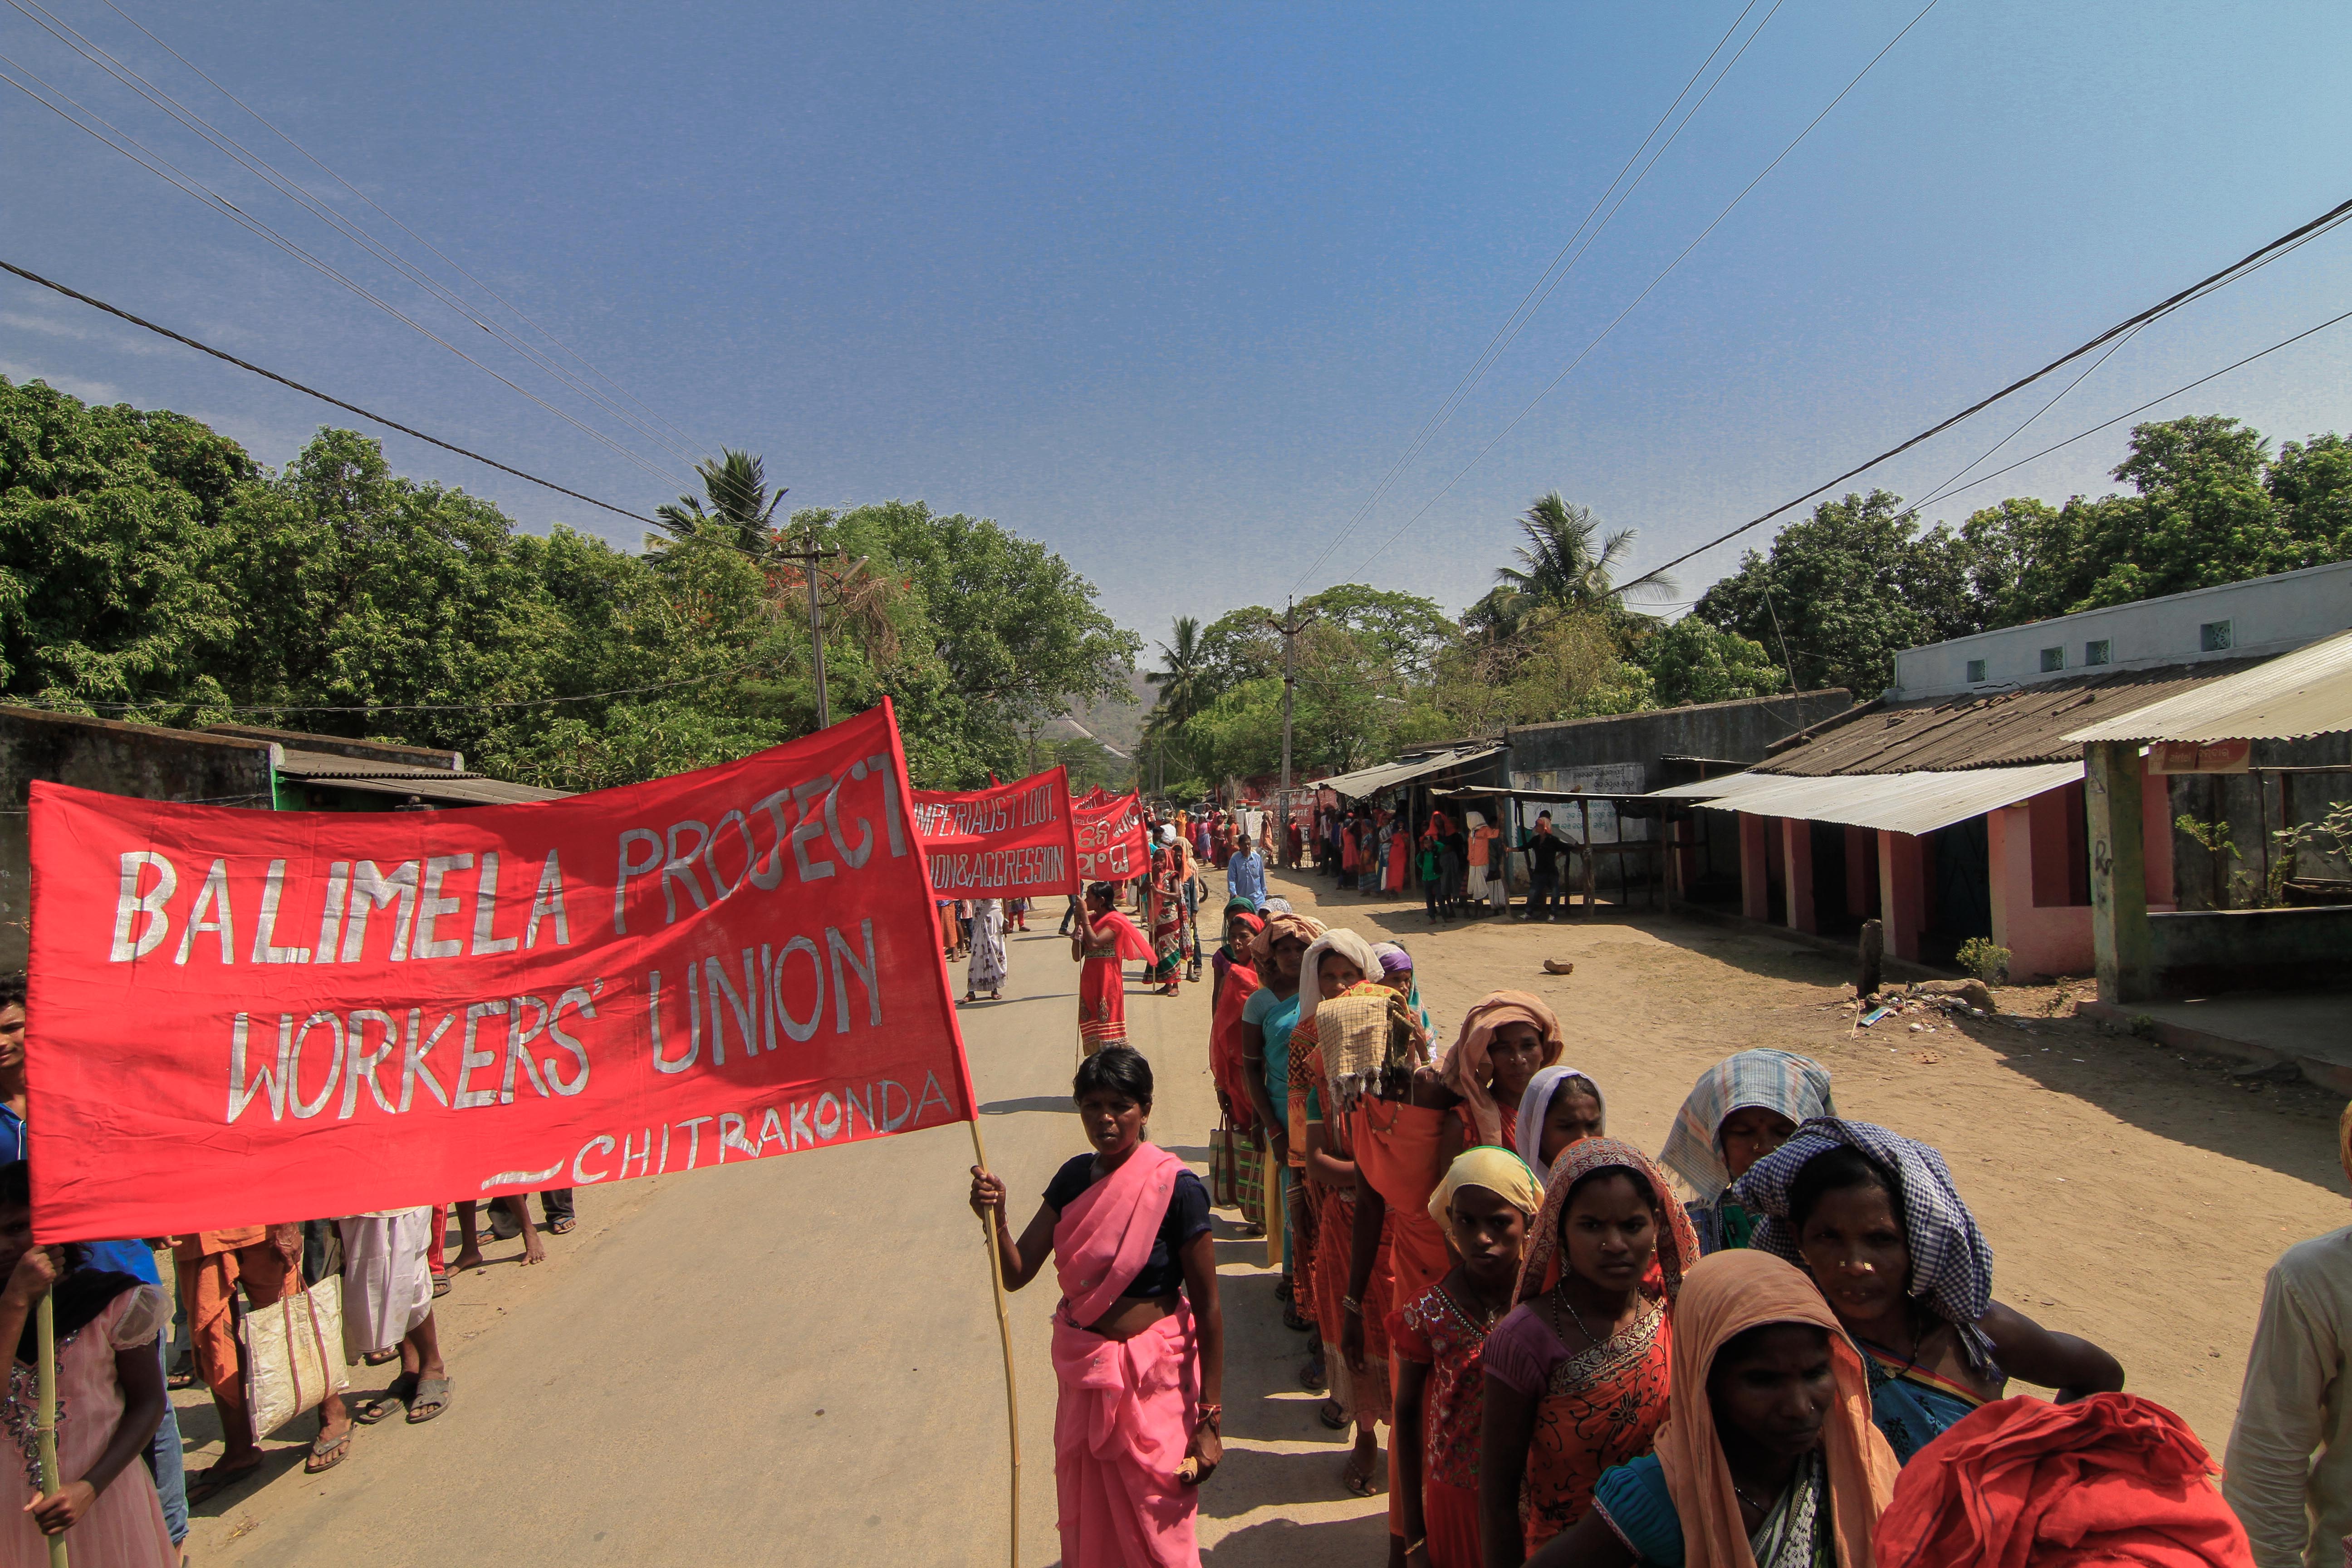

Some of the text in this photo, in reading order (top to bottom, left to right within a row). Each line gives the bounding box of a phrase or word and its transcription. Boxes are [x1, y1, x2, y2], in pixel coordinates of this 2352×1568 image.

[2170, 753, 2191, 762] airtel
[914, 784, 1057, 836] IMPERIALIST LOOT,
[111, 752, 907, 964] BALIMELA PROJECT
[925, 846, 1065, 889] ION&AGGRESSION
[227, 918, 882, 1123] WORKERS' UNION
[573, 1069, 952, 1184] CHITRAKONDA
